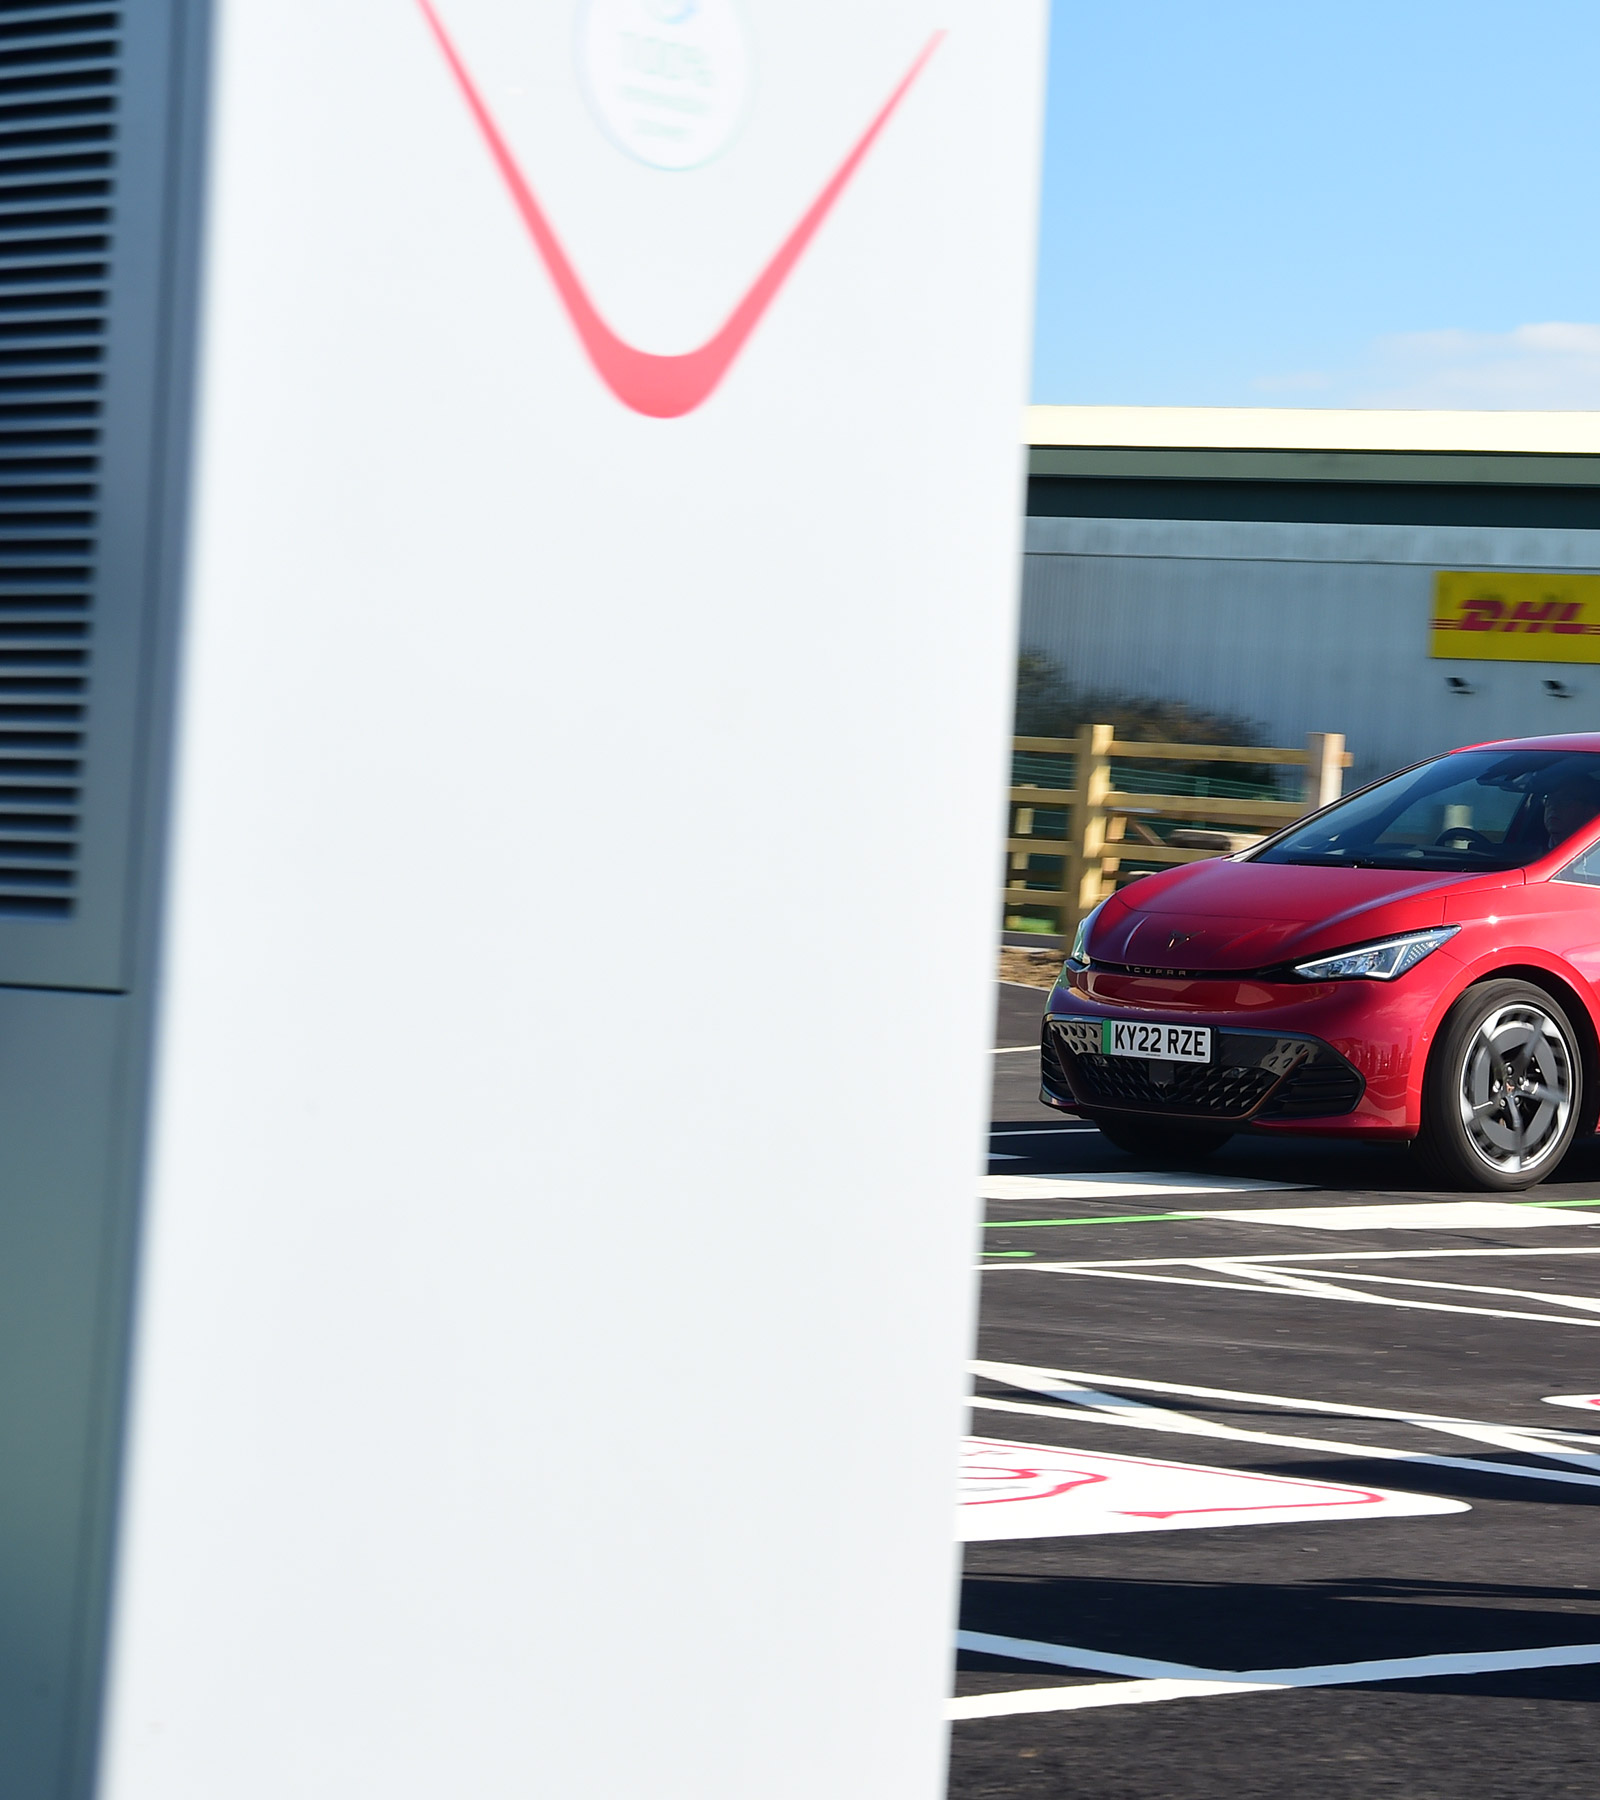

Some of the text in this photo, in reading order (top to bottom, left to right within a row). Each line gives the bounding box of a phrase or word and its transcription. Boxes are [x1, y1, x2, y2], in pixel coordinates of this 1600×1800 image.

[1457, 599, 1583, 635] DHL
[1133, 966, 1187, 976] CUPRA
[1114, 1023, 1206, 1057] KY22 RZE
